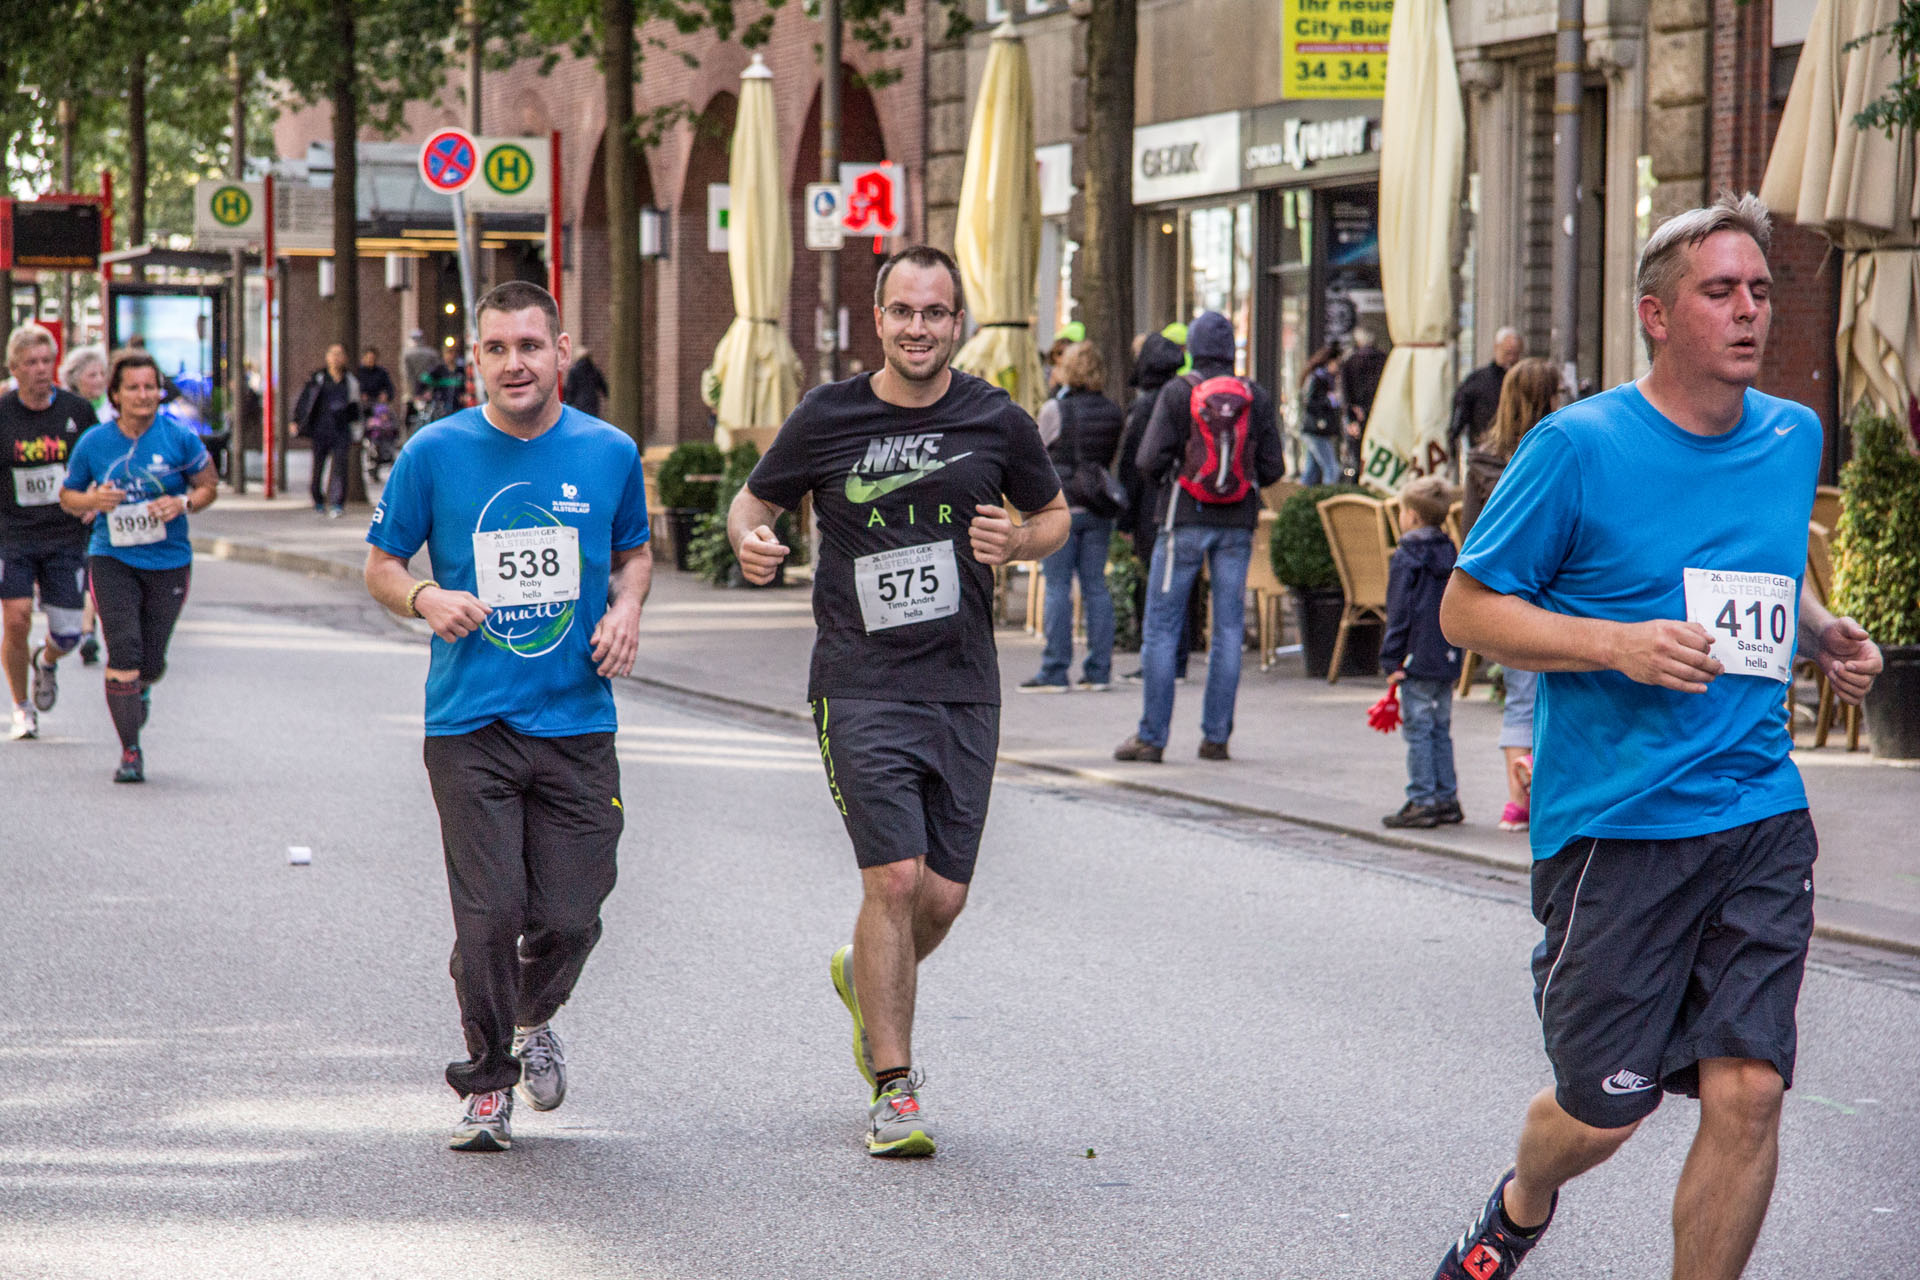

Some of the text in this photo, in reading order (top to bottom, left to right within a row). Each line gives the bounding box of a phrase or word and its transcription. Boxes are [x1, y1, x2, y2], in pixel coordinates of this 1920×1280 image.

[1338, 0, 1394, 12] neue
[1295, 18, 1390, 41] City-Bür
[1296, 61, 1327, 80] 34
[1338, 61, 1369, 80] 34
[860, 433, 945, 473] NIKE
[26, 475, 55, 493] 807
[504, 530, 540, 539] BARMER
[541, 528, 557, 536] GEK
[495, 537, 557, 548] ALSTERLAUF
[874, 553, 935, 570] ALSTERLAUF
[881, 549, 915, 561] BARMER
[498, 548, 560, 580] 538
[520, 580, 542, 588] Roby
[879, 565, 939, 602] 575
[1711, 573, 1724, 582] 26.
[1725, 574, 1771, 585] BARMER
[522, 590, 542, 599] hella
[1712, 584, 1790, 600] ALSTERLAUF
[888, 600, 908, 610] Timo
[904, 609, 923, 619] hella
[1715, 599, 1787, 645] 410
[1737, 640, 1774, 654] Sascha
[1745, 656, 1768, 669] hella
[1612, 1069, 1648, 1089] NIKE
